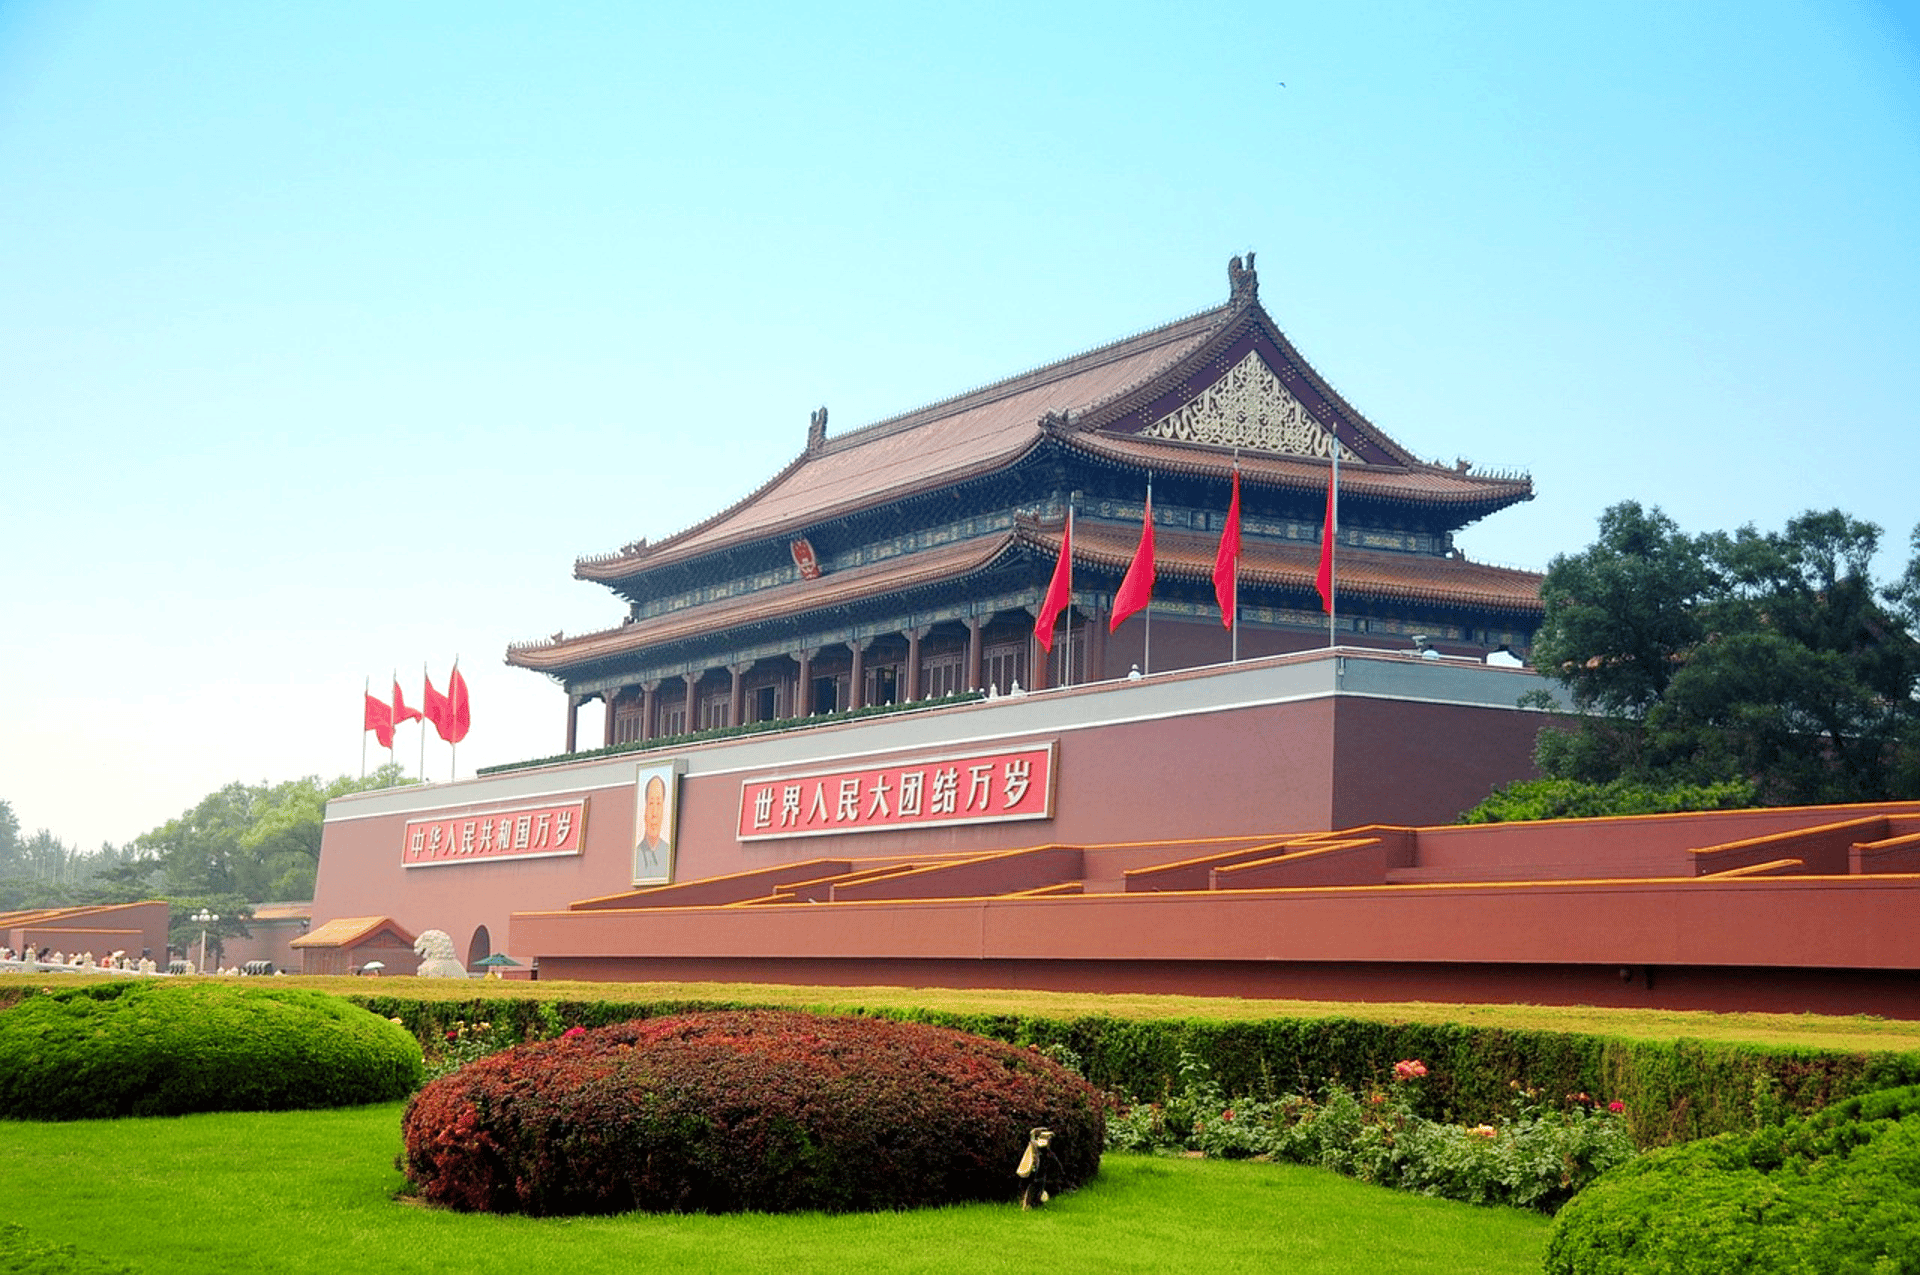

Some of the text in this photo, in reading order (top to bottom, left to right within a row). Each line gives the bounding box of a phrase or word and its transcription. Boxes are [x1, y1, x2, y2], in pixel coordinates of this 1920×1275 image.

[753, 758, 1032, 830] 世界人民大团结万岁
[411, 810, 573, 859] 中华人民共和国万岁
